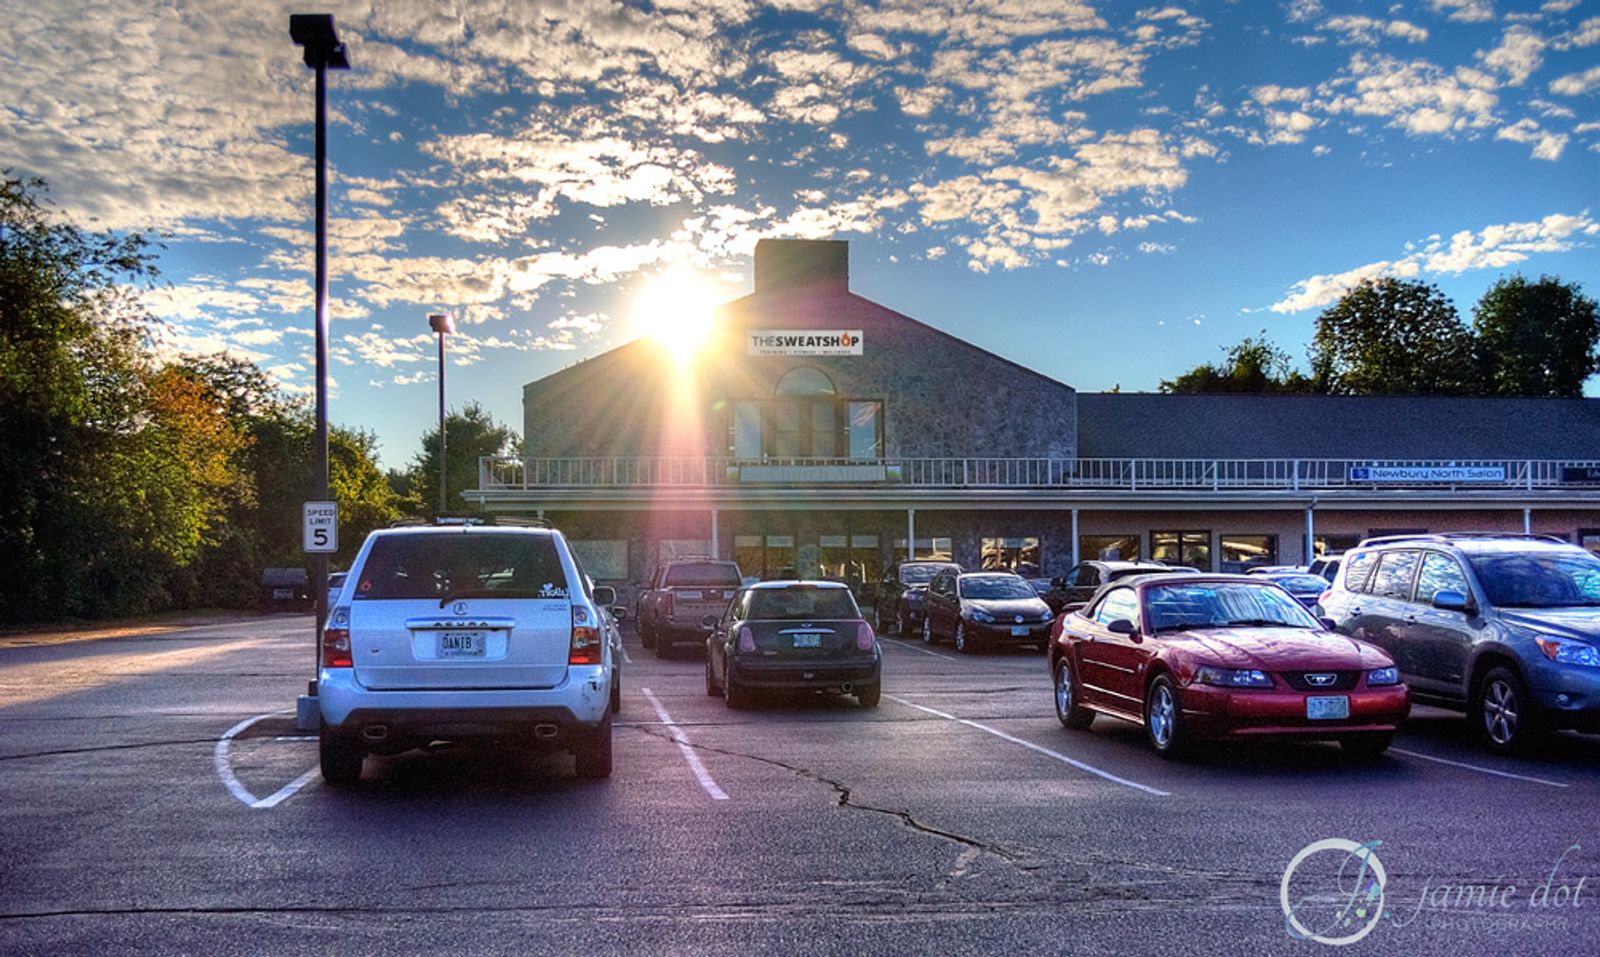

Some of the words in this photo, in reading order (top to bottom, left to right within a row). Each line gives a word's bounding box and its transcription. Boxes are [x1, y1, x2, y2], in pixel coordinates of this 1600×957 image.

[1372, 469, 1429, 479] Newbury
[1431, 469, 1464, 478] North
[1467, 469, 1502, 478] Salon
[307, 508, 336, 516] SPEED
[308, 517, 331, 525] LIMIT
[313, 528, 328, 546] 5
